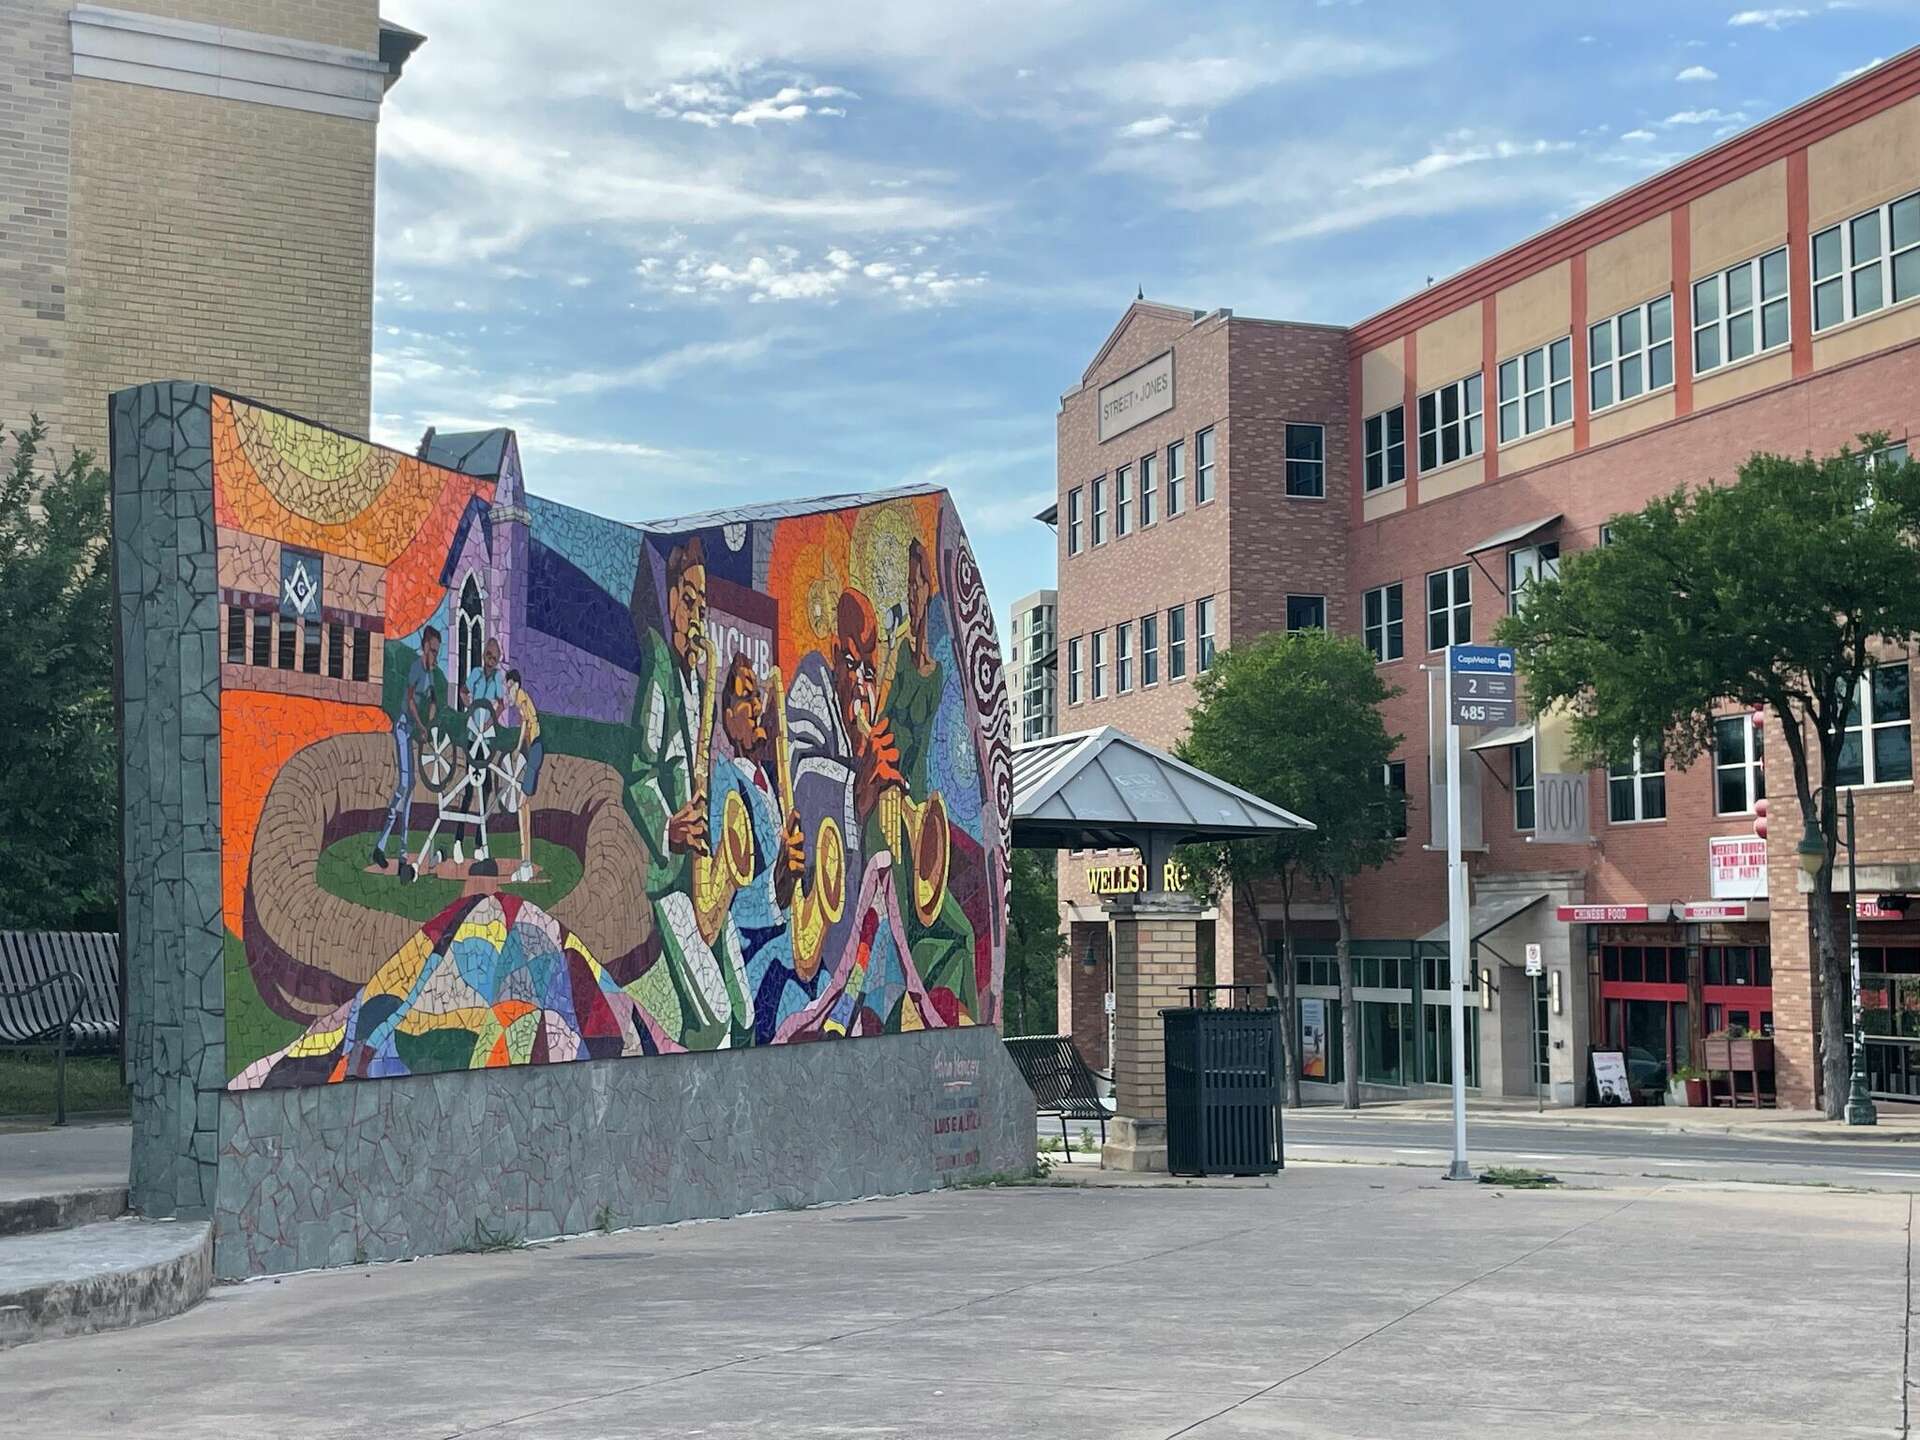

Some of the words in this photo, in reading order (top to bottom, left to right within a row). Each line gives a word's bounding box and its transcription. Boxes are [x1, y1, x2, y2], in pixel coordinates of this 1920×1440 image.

[1103, 391, 1134, 420] STREET
[1140, 373, 1168, 402] JONES
[1457, 654, 1496, 665] CapMetro
[1468, 679, 1478, 694] 2
[1460, 704, 1486, 721] 485
[1540, 778, 1585, 832] 1000
[1086, 864, 1140, 894] WELLS
[1607, 908, 1628, 920] FOOD
